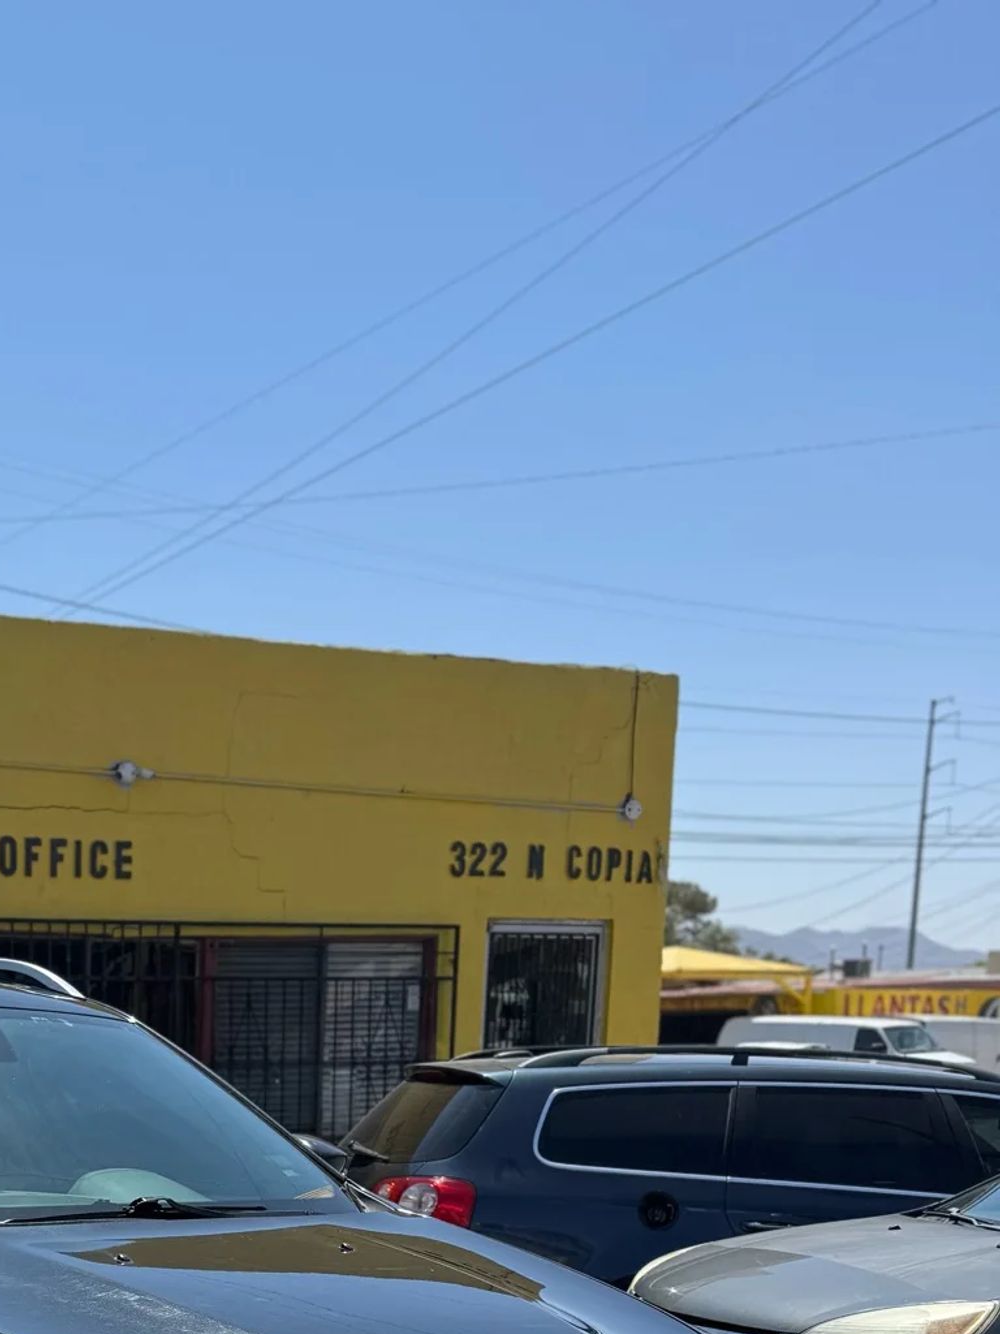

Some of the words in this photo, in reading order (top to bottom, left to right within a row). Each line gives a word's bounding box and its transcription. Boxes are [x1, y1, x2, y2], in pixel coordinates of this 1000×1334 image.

[450, 841, 508, 878] 322
[527, 844, 545, 880] N
[565, 845, 653, 884] COPIA
